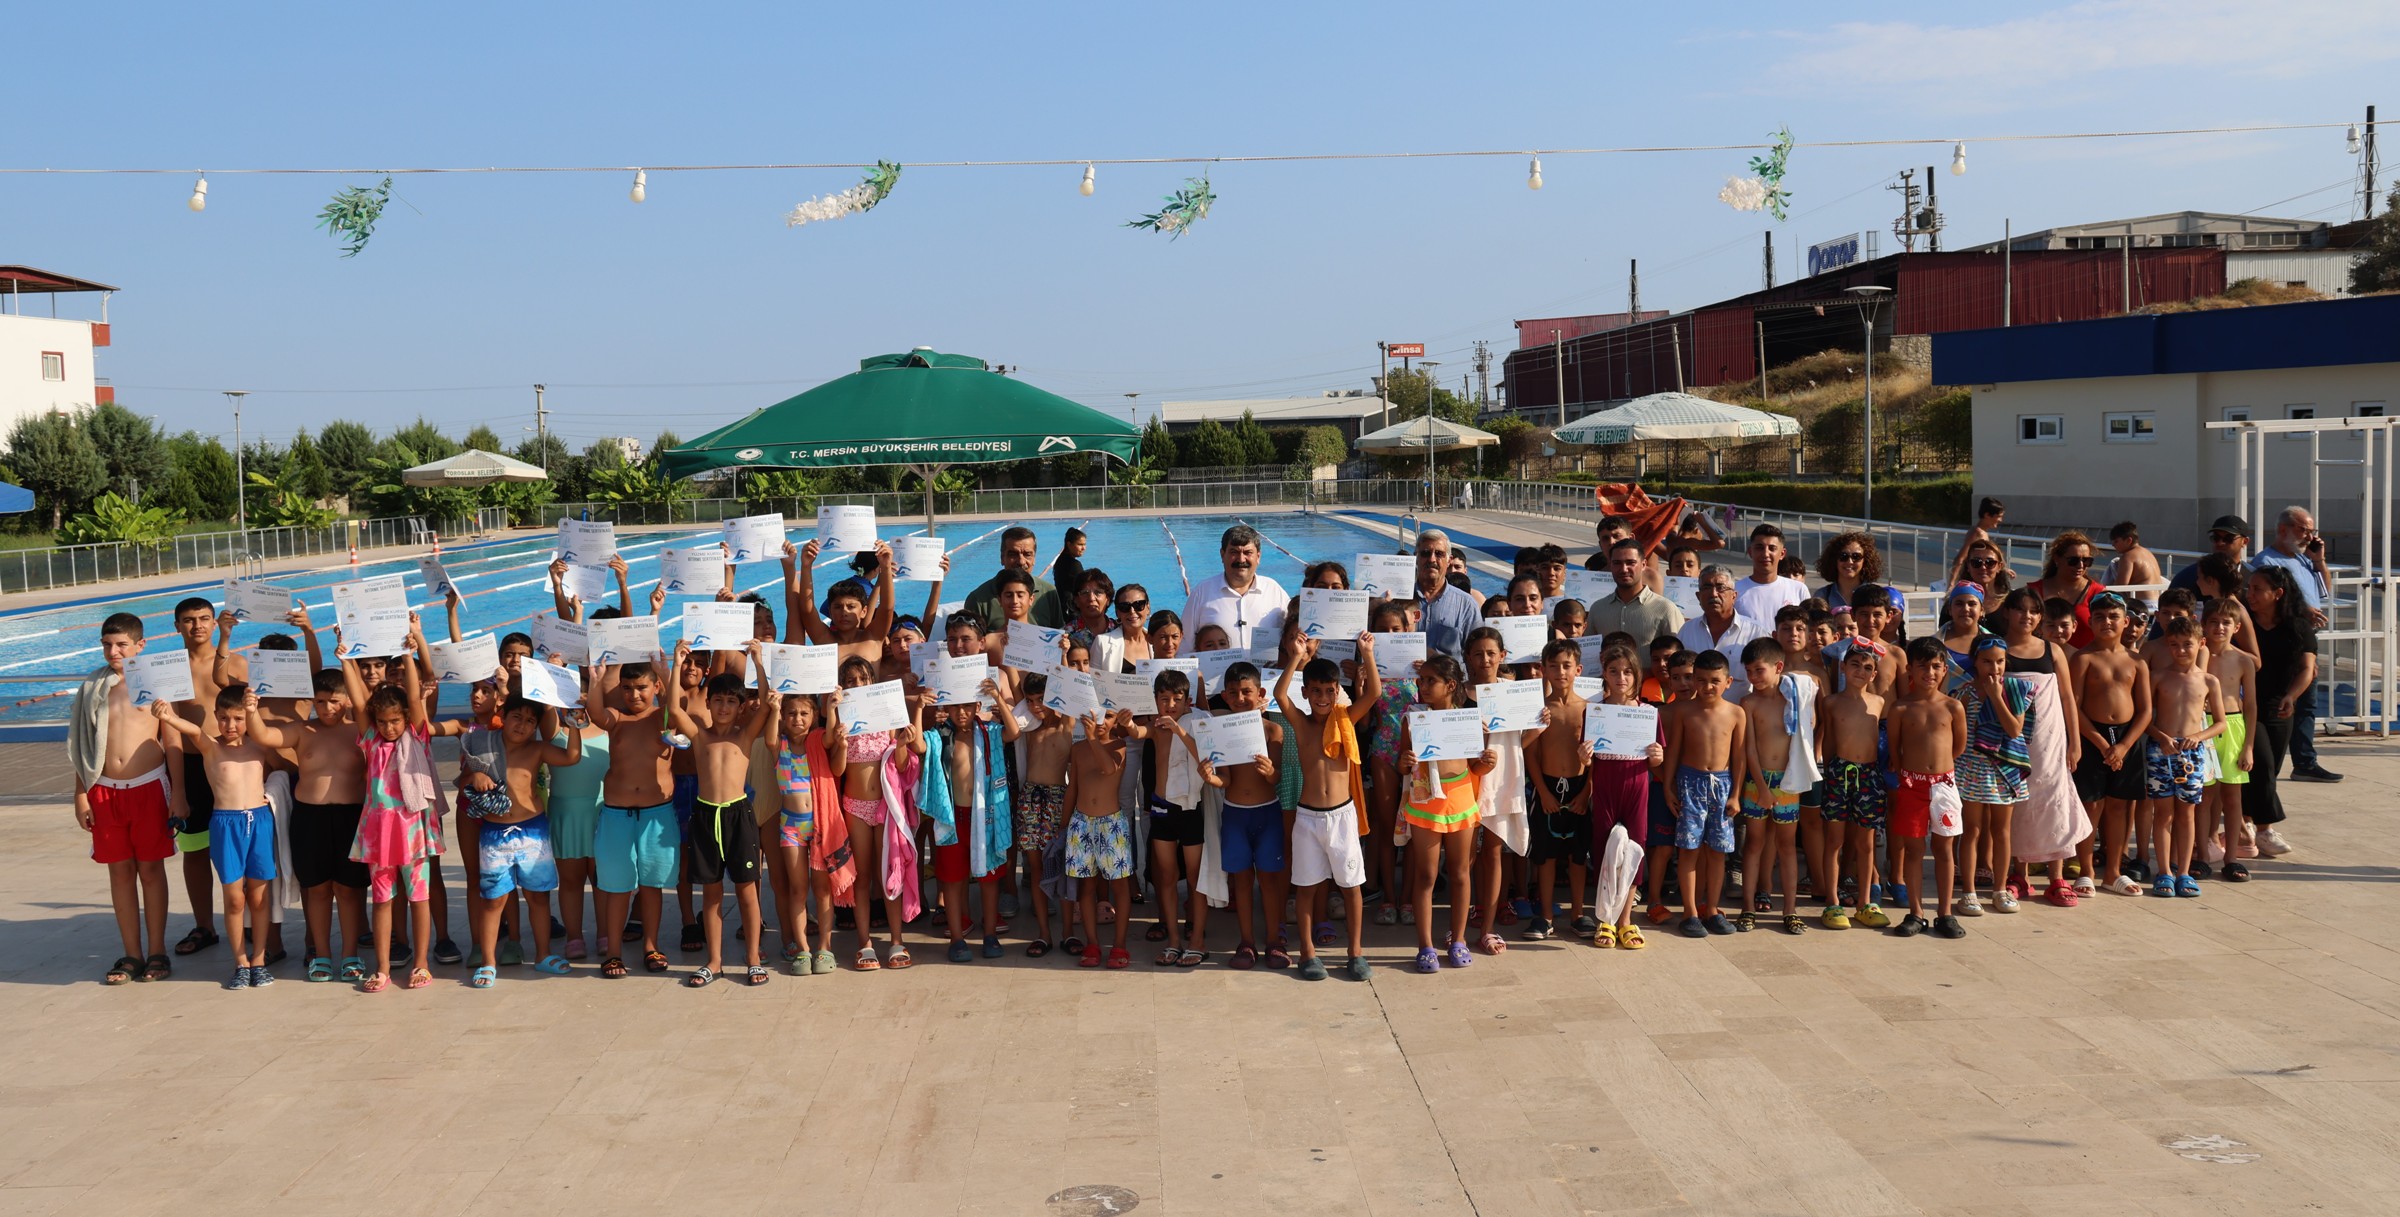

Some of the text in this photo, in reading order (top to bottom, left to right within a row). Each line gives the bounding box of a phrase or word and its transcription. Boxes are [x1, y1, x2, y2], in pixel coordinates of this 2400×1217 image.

[1820, 240, 1857, 269] ORYAP
[790, 440, 1011, 459] T.C. MERSİN BÜYÜKŞEHİR BELEDİYESİ
